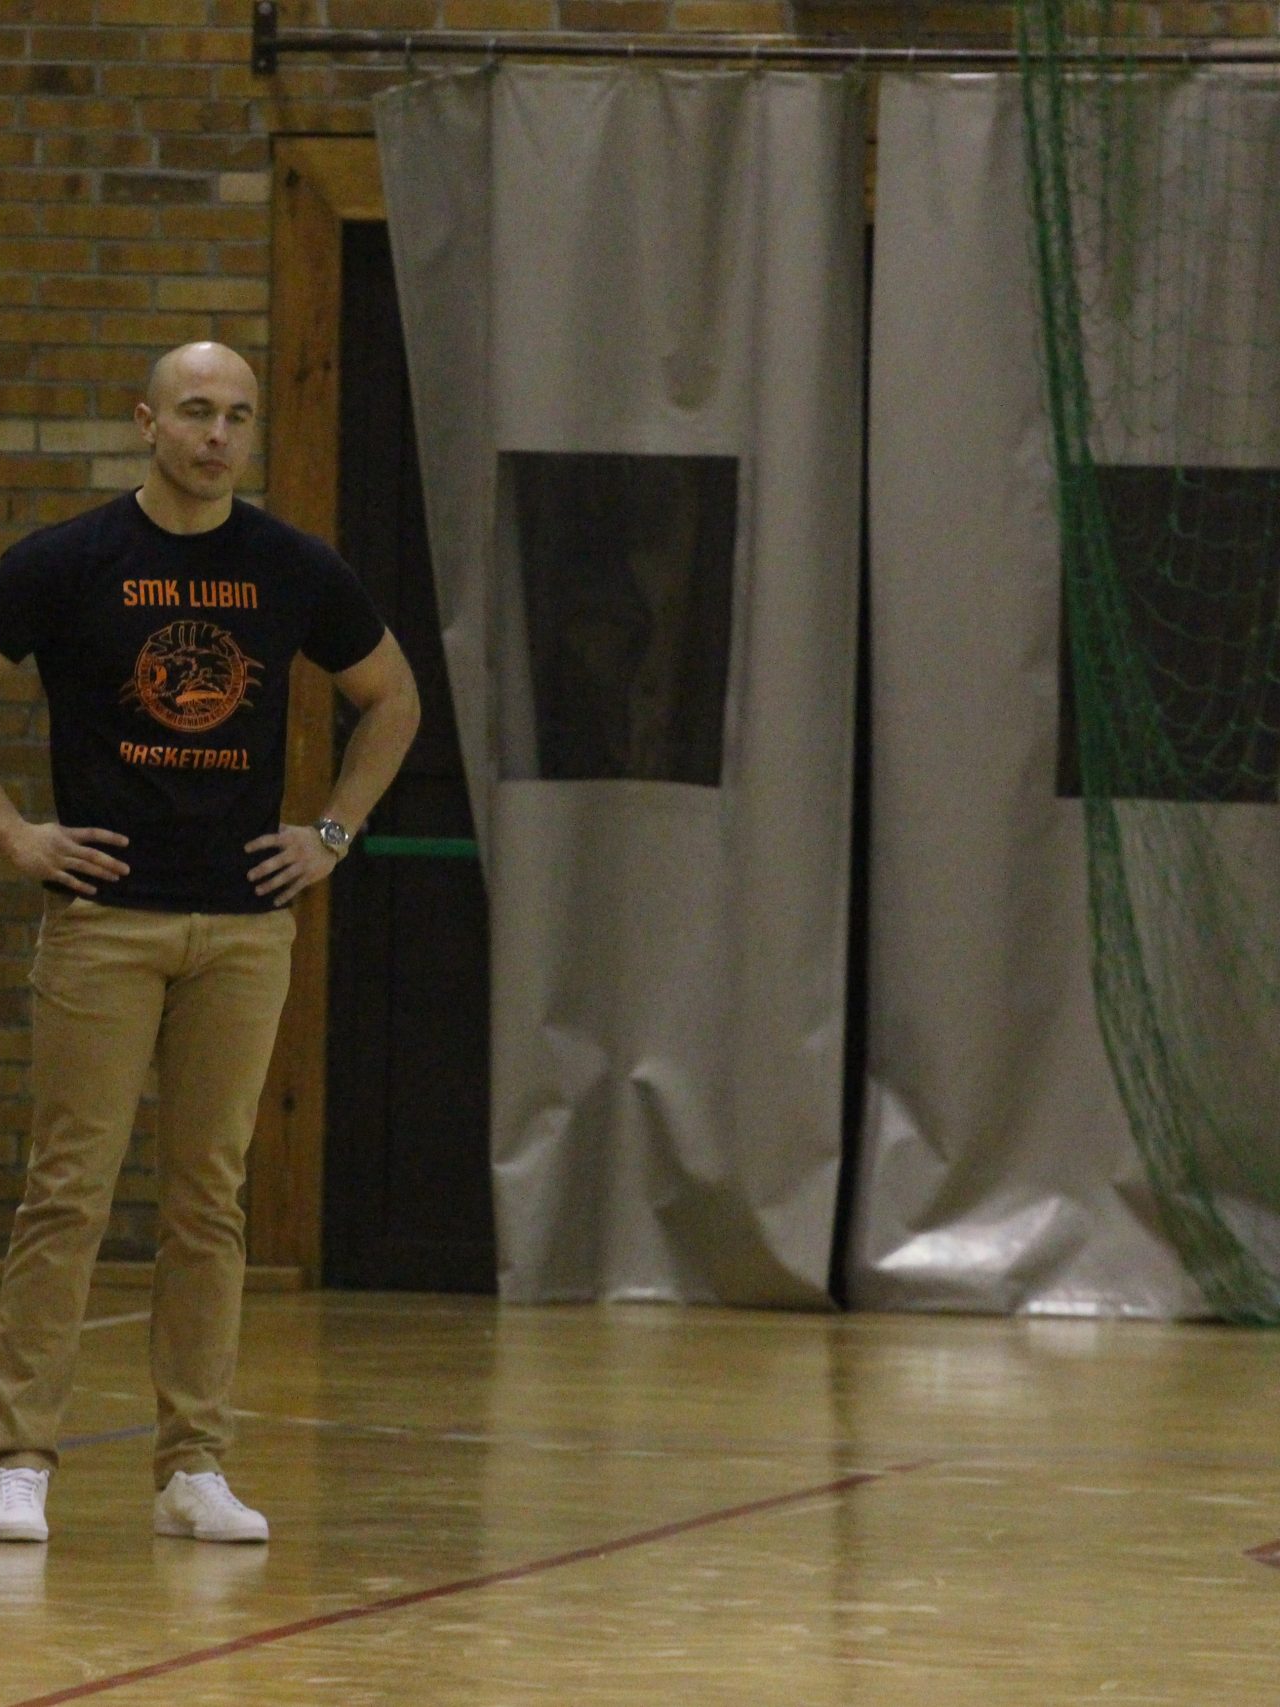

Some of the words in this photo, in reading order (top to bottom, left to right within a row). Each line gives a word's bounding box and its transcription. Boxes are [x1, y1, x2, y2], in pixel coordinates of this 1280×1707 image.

[123, 580, 180, 606] SMK
[189, 580, 258, 609] LUBIN
[120, 741, 249, 770] BASKETBALL
